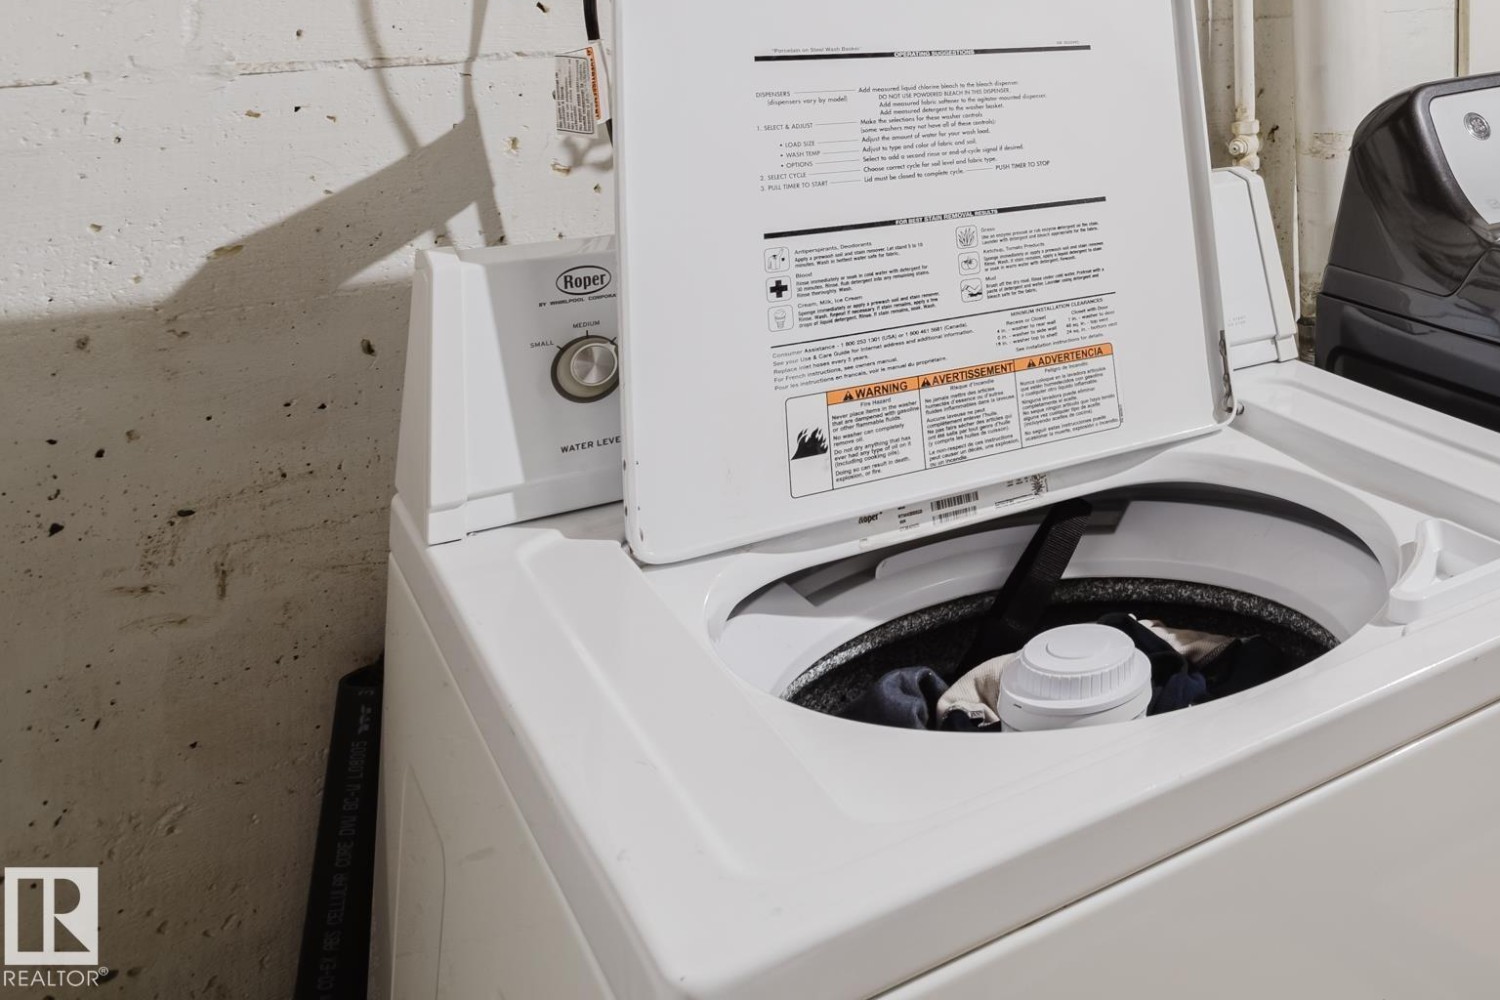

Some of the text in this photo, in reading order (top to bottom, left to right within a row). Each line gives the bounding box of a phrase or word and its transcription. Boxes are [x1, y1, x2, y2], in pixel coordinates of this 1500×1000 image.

[563, 273, 606, 290] Roper
[550, 297, 585, 306] WHIRLPOOL
[588, 293, 617, 301] CORPORA
[572, 320, 600, 329] MEDIUM
[530, 340, 554, 348] SMALL
[1038, 347, 1103, 365] ADVERTENCIA
[933, 364, 1013, 385] AVERTISSEMENT
[855, 381, 908, 398] WARNING
[560, 436, 621, 454] WATER LEVE
